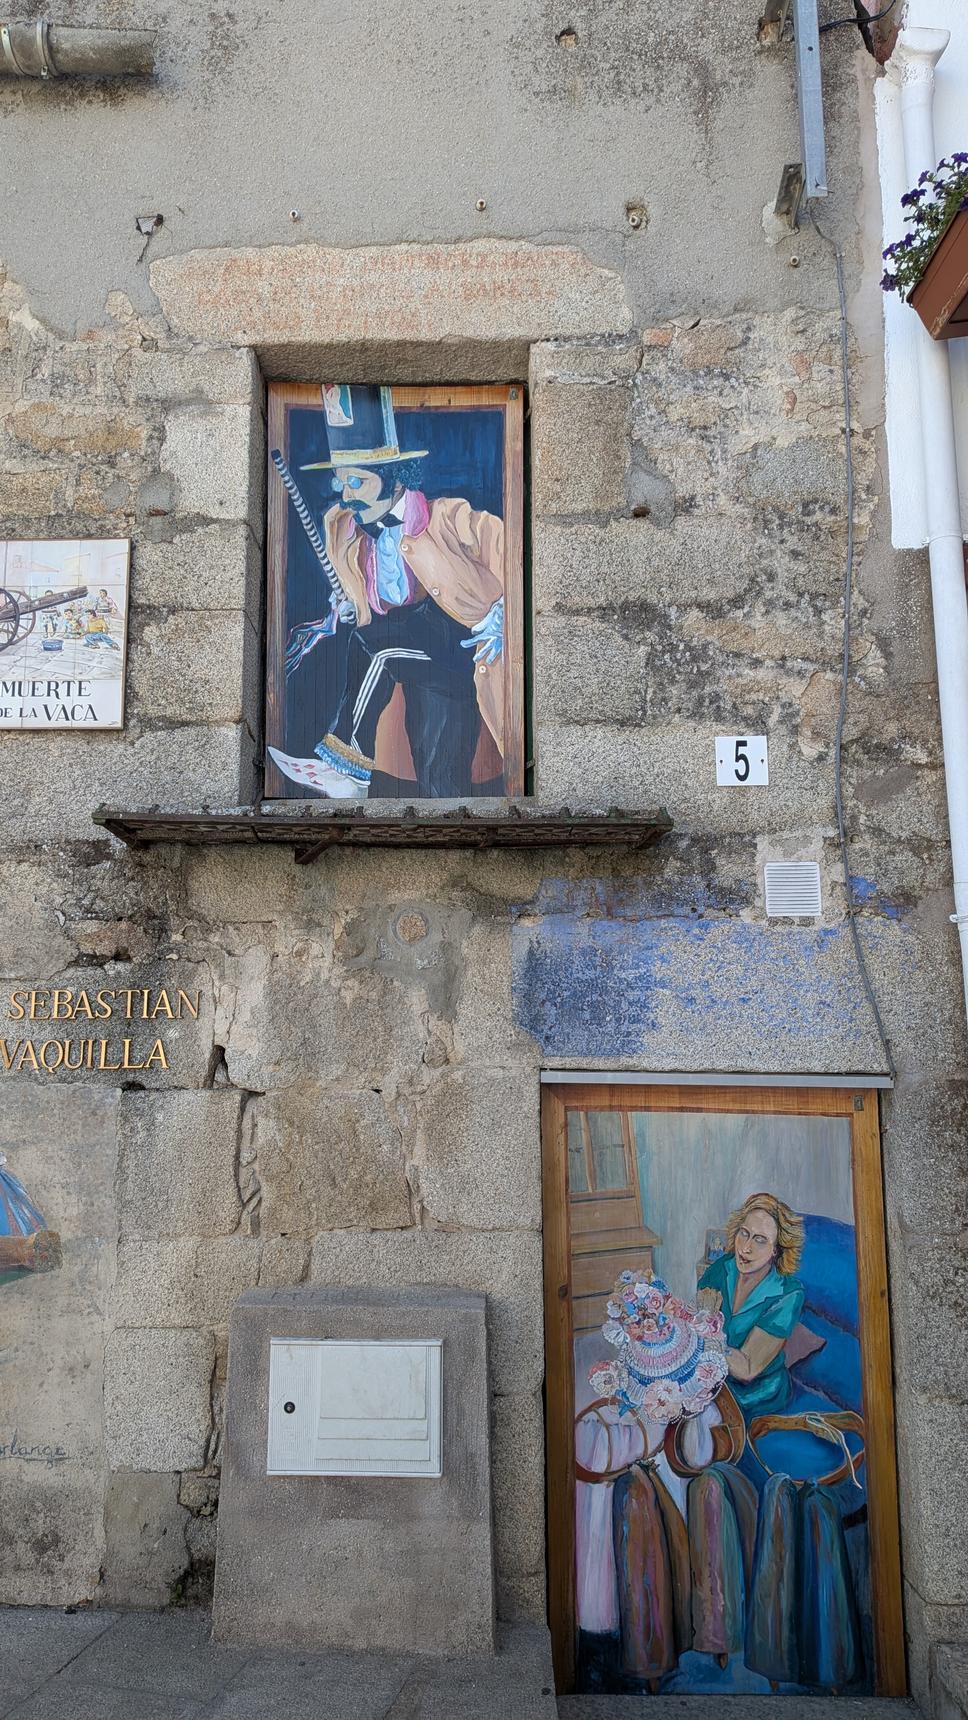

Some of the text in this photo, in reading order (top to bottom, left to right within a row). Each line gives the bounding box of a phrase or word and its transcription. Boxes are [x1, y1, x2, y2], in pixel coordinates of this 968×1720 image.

[1, 680, 92, 700] MUERTE
[19, 707, 38, 718] LA
[43, 703, 99, 722] VACA
[734, 740, 750, 782] 5
[8, 988, 201, 1021] SEBASTIAN
[0, 1038, 169, 1073] VAQUILLA
